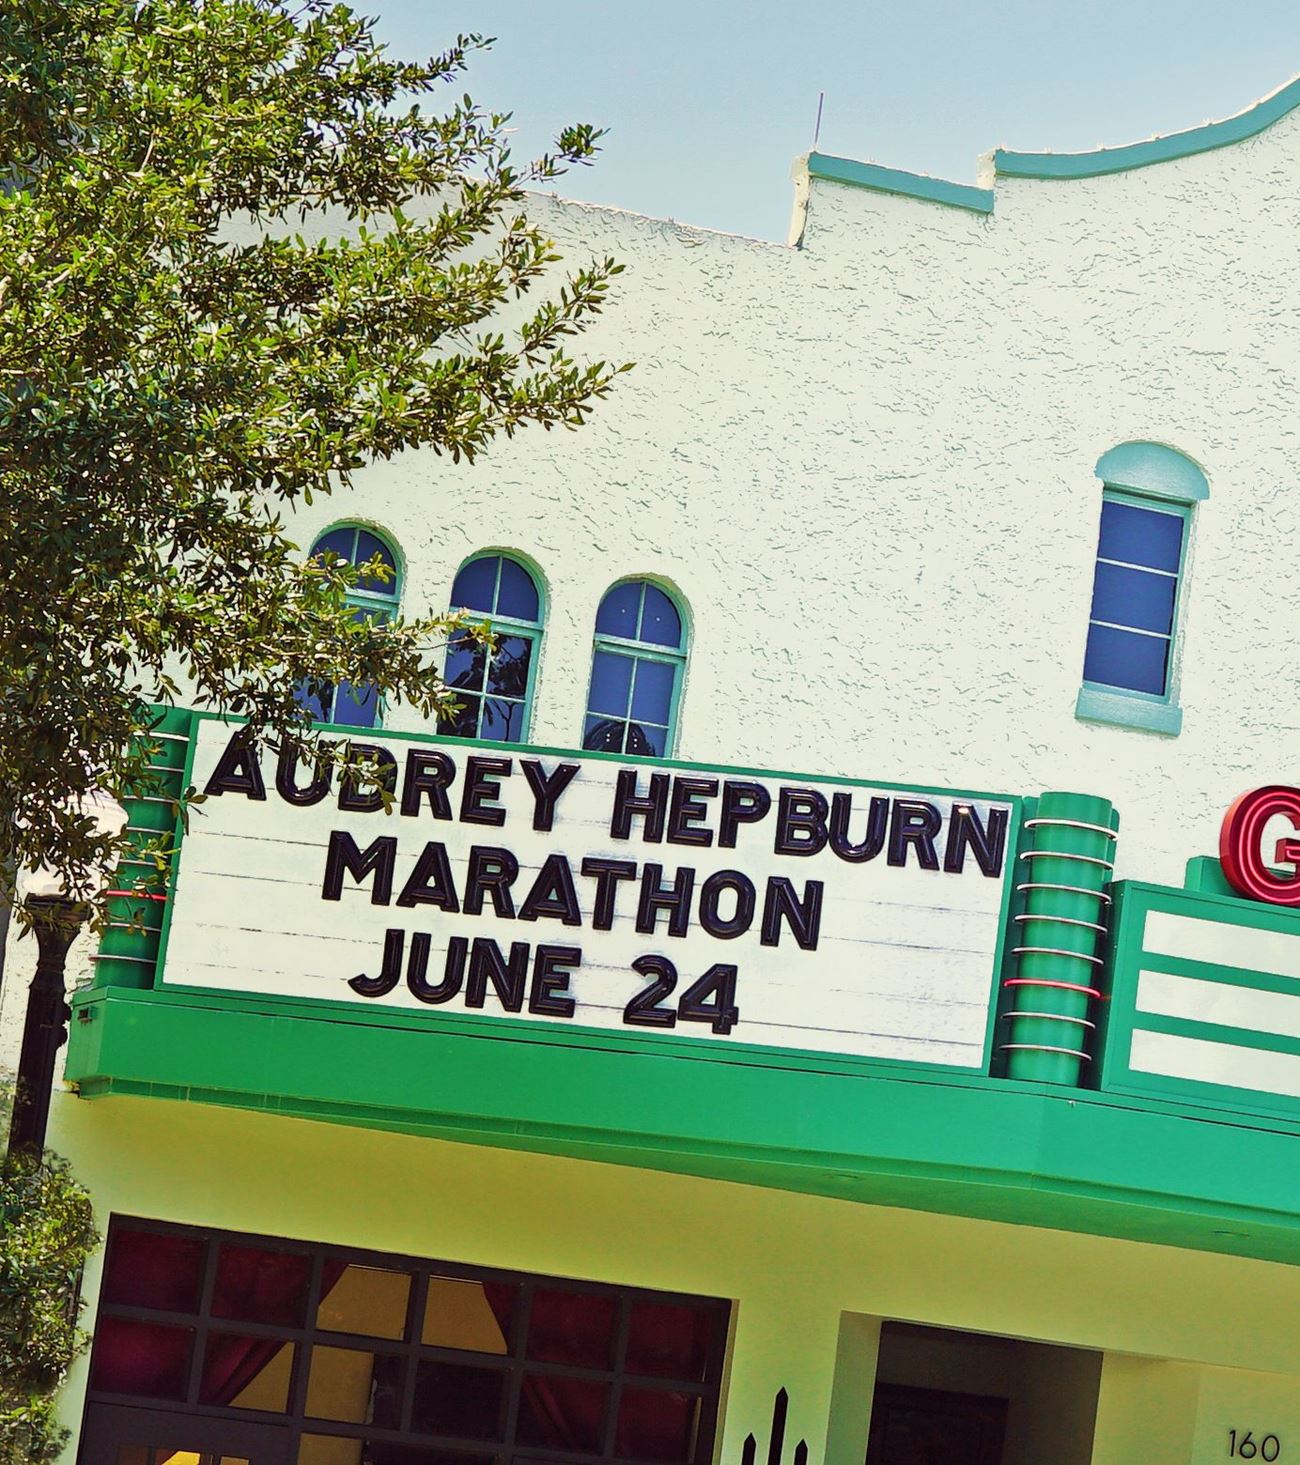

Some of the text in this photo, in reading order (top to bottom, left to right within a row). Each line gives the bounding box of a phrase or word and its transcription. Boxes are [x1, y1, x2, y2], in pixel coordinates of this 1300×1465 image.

[203, 730, 1008, 878] AUDREY HEPBURN
[322, 830, 824, 951] MARATHON
[348, 928, 739, 1035] JUNE 24
[1229, 1429, 1280, 1462] 160
